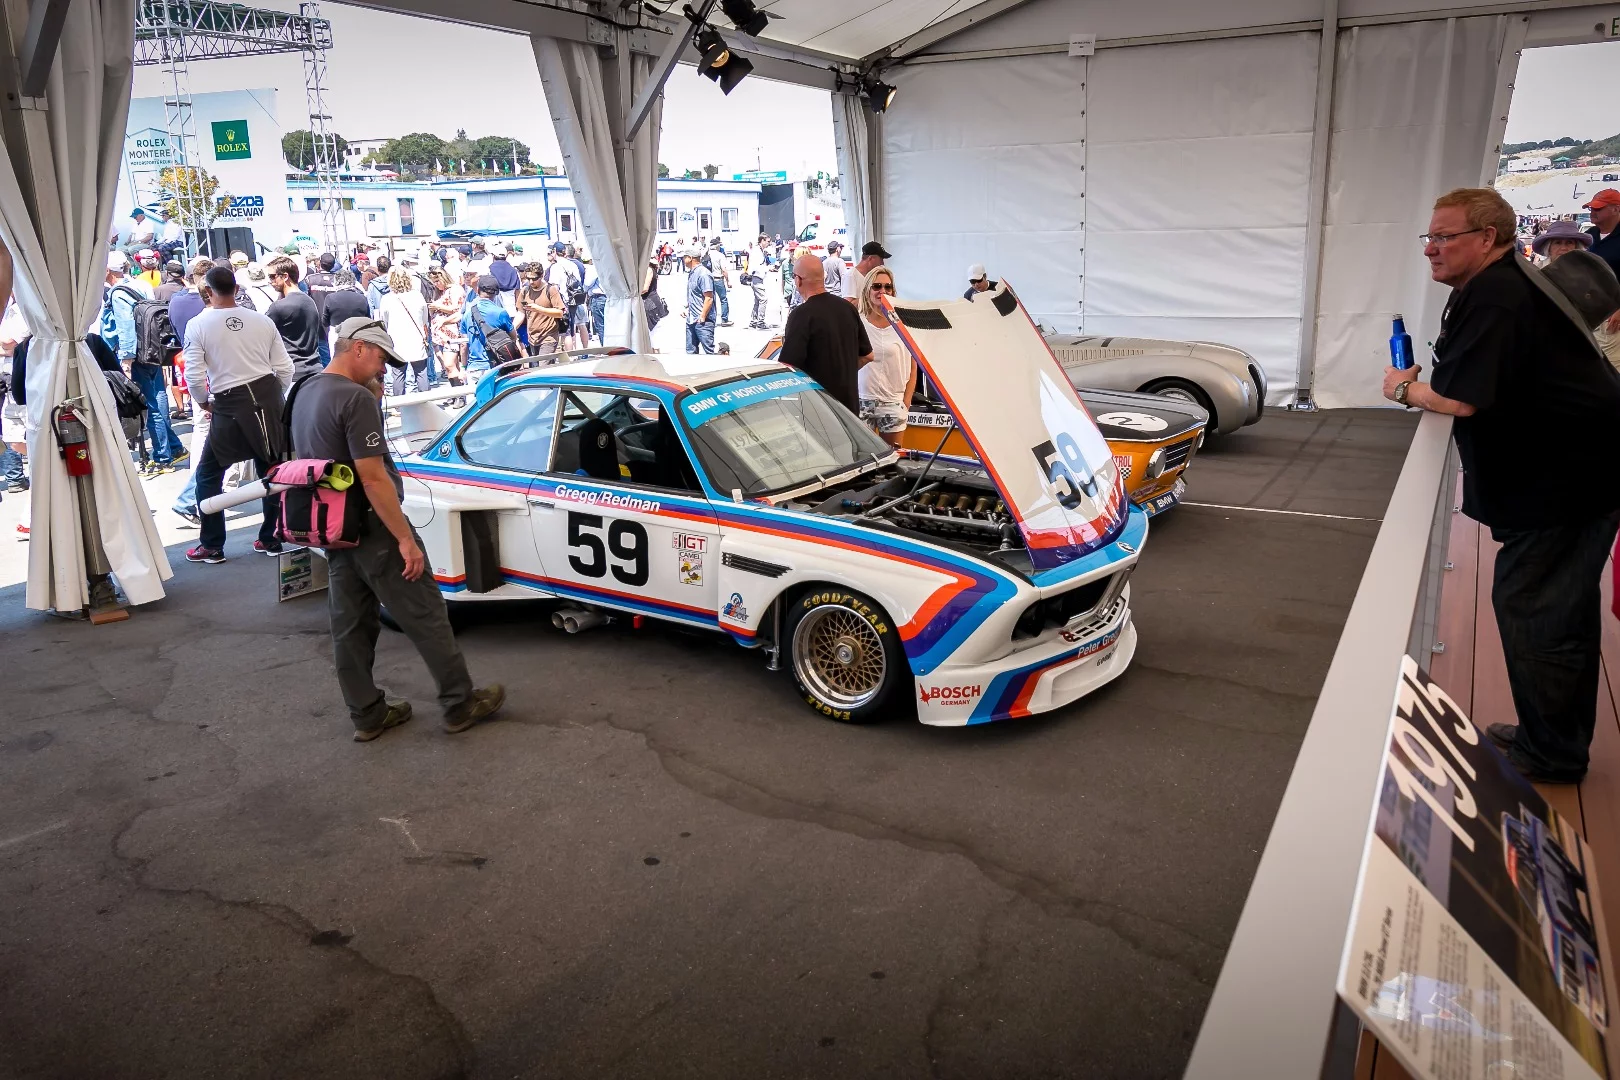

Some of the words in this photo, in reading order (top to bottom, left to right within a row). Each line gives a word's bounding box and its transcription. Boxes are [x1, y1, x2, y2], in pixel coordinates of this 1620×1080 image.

[136, 138, 167, 148] ROLEX
[217, 142, 248, 153] ROLEX
[687, 396, 718, 415] BMW
[717, 392, 733, 403] OF
[731, 385, 766, 398] NORTH
[918, 414, 933, 425] drive
[1031, 432, 1099, 511] 59
[554, 484, 661, 513] Gregg/Redman
[1156, 494, 1174, 508] BMW
[567, 510, 650, 588] 59
[679, 551, 700, 560] CAMEL
[803, 592, 888, 635] GOODYEAR
[1077, 642, 1100, 658] Peter
[930, 684, 981, 699] BOSCH
[805, 694, 851, 720] EAGLE
[1387, 654, 1479, 852] 1975
